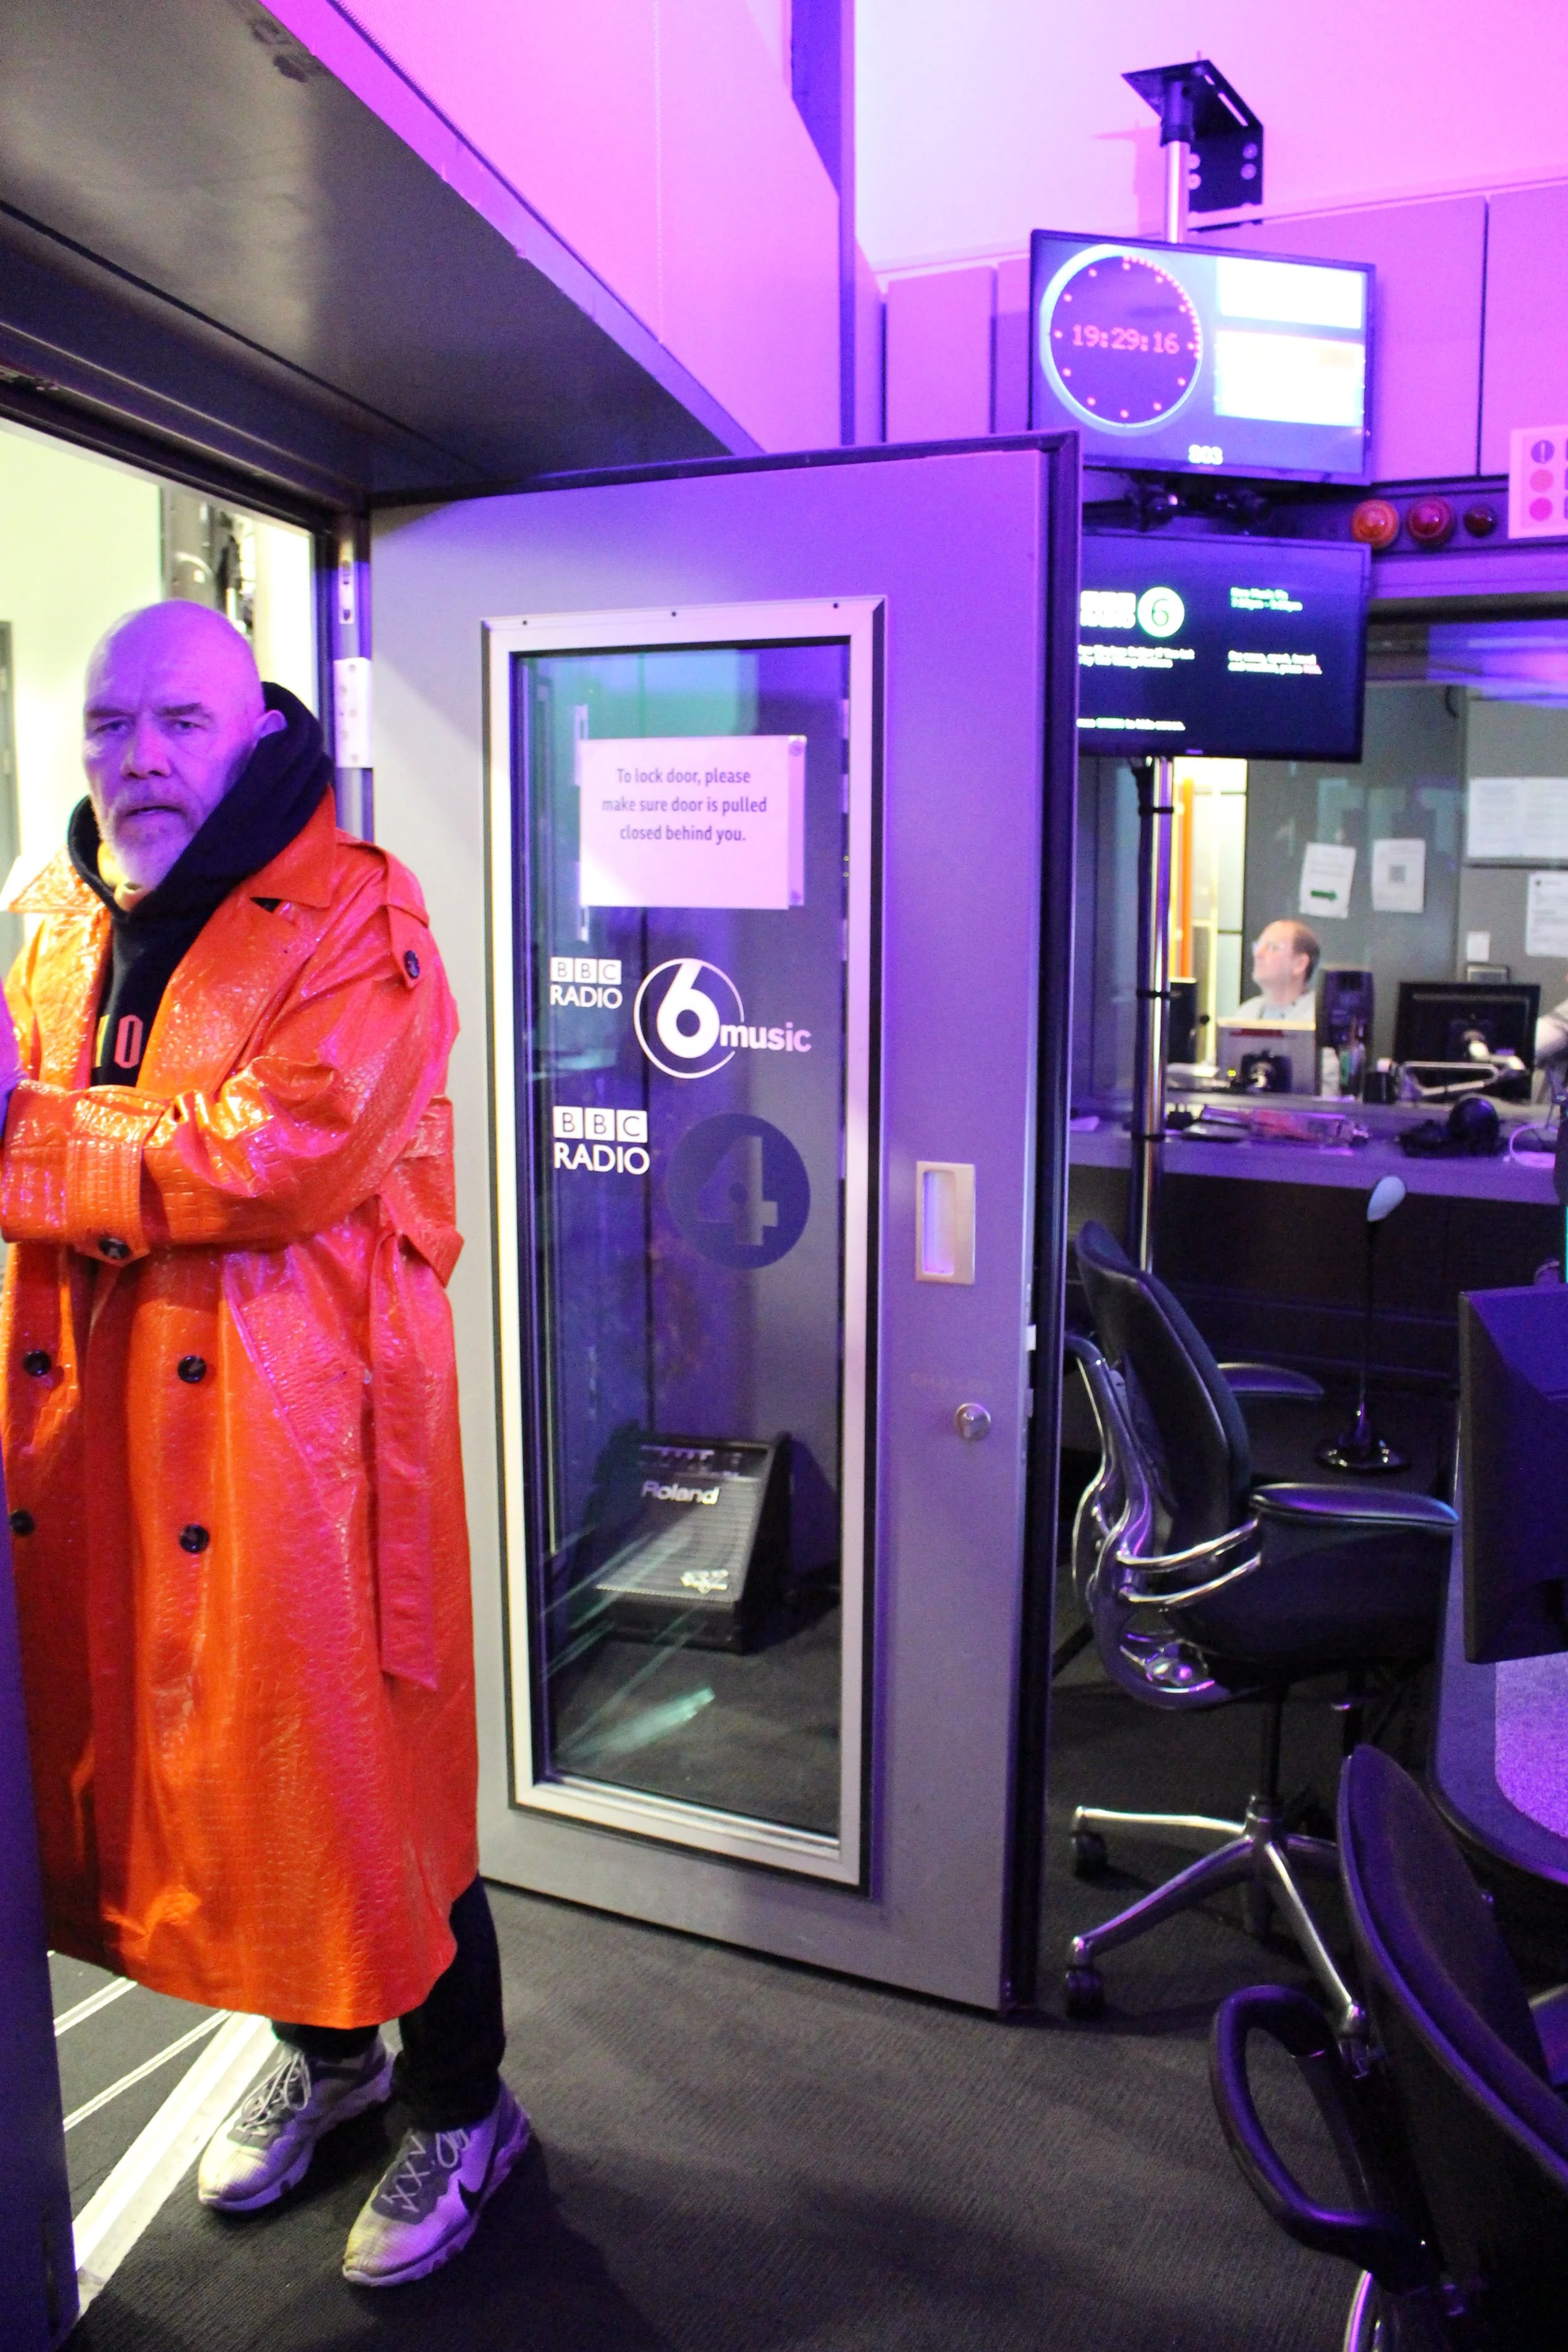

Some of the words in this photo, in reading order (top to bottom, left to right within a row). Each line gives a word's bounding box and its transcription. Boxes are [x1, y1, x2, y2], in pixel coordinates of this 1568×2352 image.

[1072, 323, 1180, 354] 19:29:16
[617, 768, 632, 783] To
[635, 768, 663, 783] lock
[667, 768, 701, 786] door,
[705, 768, 751, 787] please
[602, 797, 636, 812] make
[640, 800, 667, 812] sure
[672, 797, 702, 812] door
[707, 797, 718, 812] is
[723, 797, 767, 816] pulled
[620, 825, 662, 840] closed
[666, 826, 712, 841] behind
[716, 830, 746, 845] you.
[551, 956, 622, 985] BBC
[550, 985, 623, 1009] RADIO
[720, 1022, 812, 1052] music
[553, 1106, 647, 1143] BBC
[554, 1142, 650, 1175] RADIO
[694, 1135, 778, 1246] 4
[641, 1480, 720, 1505] Roland
